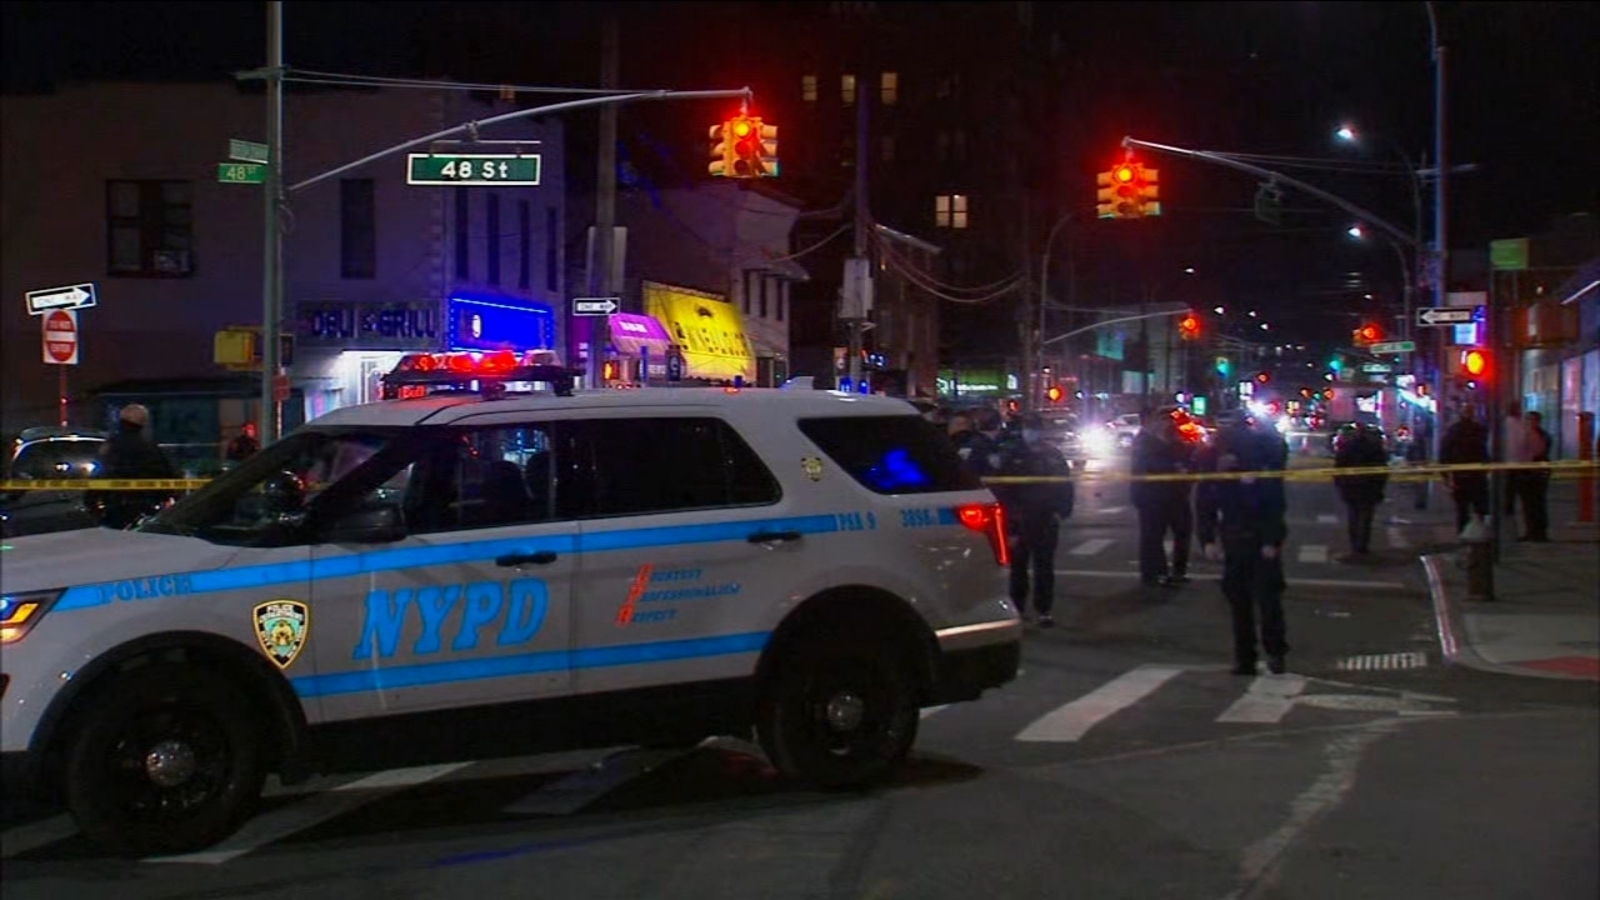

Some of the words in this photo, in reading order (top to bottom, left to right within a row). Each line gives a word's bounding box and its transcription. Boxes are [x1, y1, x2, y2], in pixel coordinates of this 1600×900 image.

[226, 166, 246, 180] 48
[441, 161, 472, 179] 48
[481, 161, 508, 179] St
[311, 309, 354, 339] DELI
[362, 312, 378, 333] &
[379, 309, 436, 339] GRILL
[98, 576, 193, 604] POLICE
[352, 577, 550, 660] NYPD
